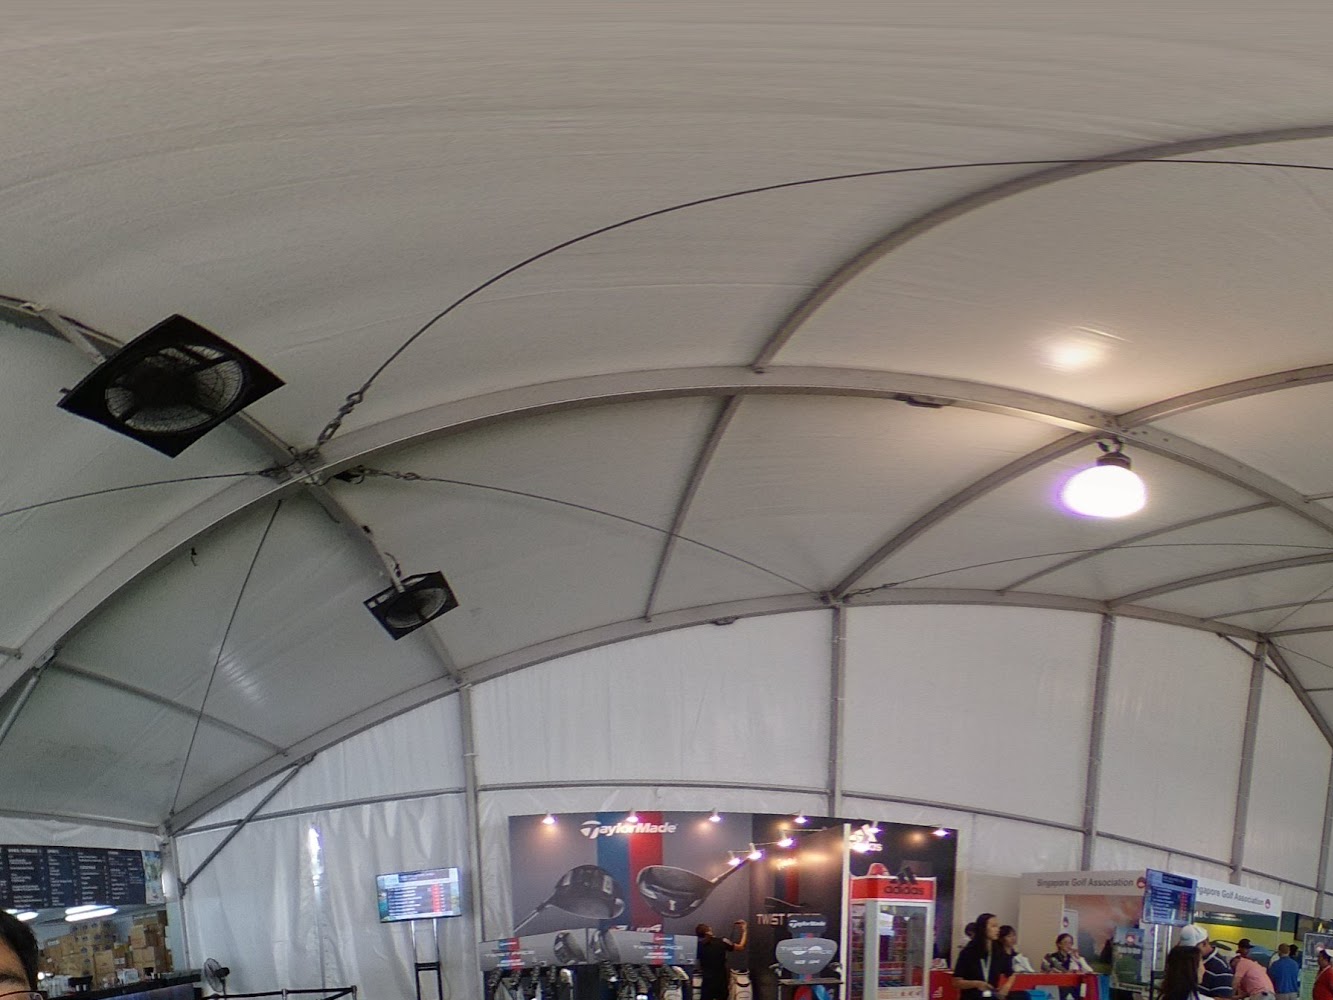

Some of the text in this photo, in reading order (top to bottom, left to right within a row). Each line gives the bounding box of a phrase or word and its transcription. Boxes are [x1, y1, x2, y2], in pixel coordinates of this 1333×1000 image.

[580, 820, 677, 839] TaylorMade
[1036, 878, 1134, 888] Singapore Golf Association
[885, 885, 925, 895] adidas
[1221, 890, 1234, 899] Golf
[756, 913, 785, 926] TWIST
